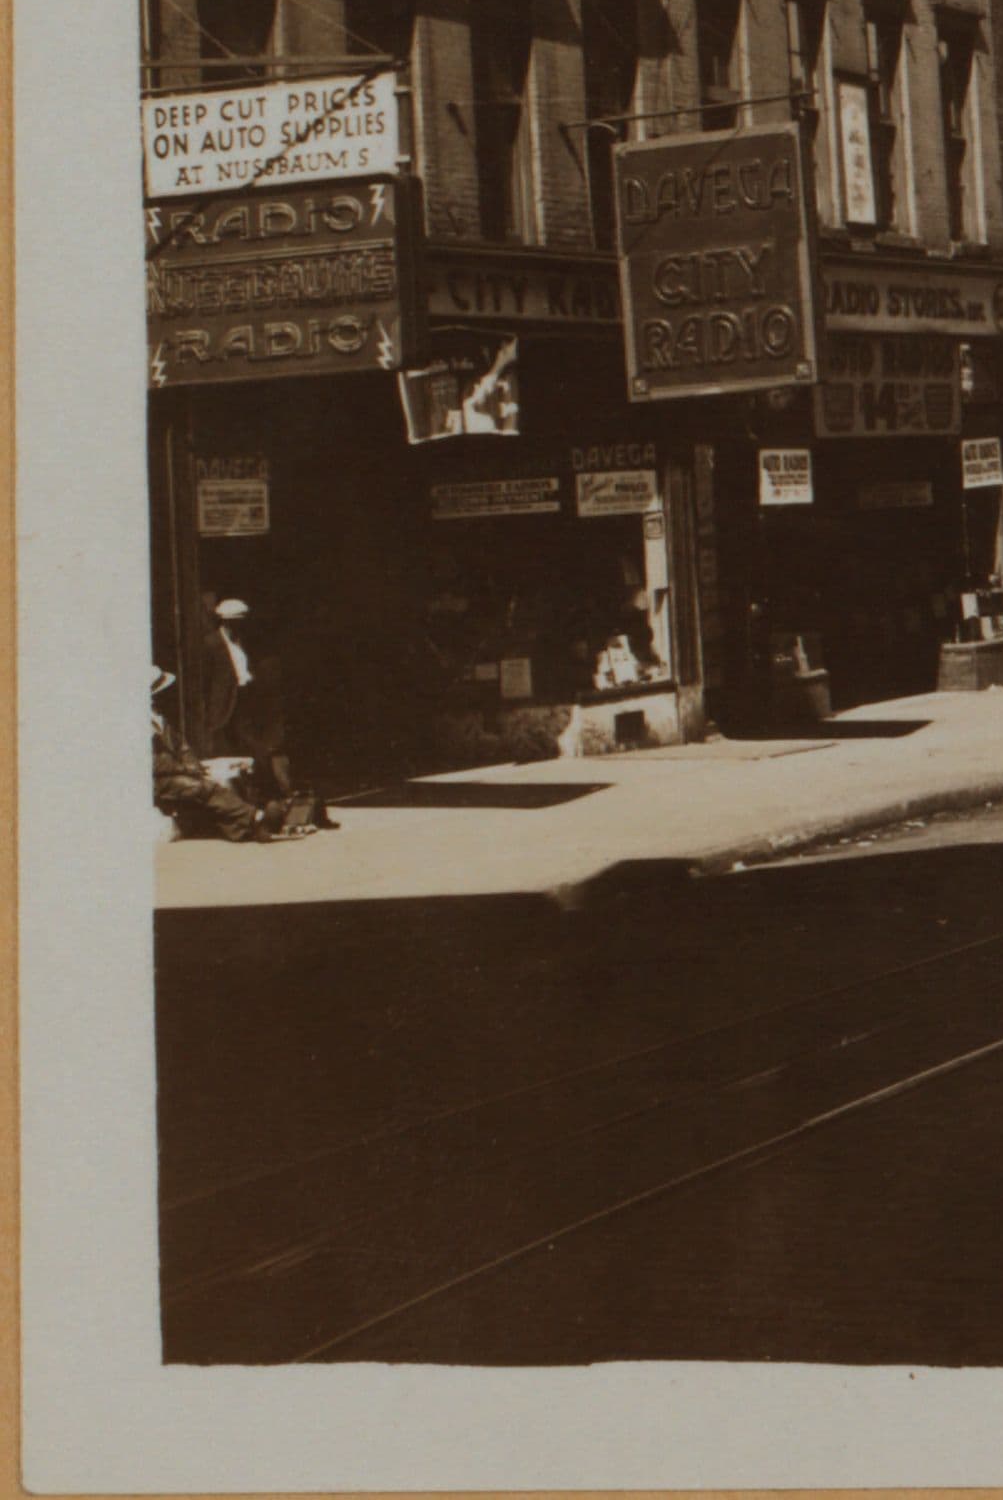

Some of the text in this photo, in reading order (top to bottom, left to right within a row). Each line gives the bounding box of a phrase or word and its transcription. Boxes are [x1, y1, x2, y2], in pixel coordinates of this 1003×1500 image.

[154, 87, 376, 130] DEEP CUT PRICES
[153, 111, 386, 160] ON AUTO SUPPLIES
[174, 165, 205, 187] AT
[623, 158, 794, 224] DAVEGA
[169, 195, 364, 245] RADIO
[446, 270, 529, 314] CITY
[654, 237, 776, 308] CITY
[826, 280, 881, 314] ADIO
[886, 285, 965, 319] STORES
[174, 314, 369, 362] RADIO
[640, 303, 796, 370] RADIO
[571, 443, 657, 470] DAVEGA
